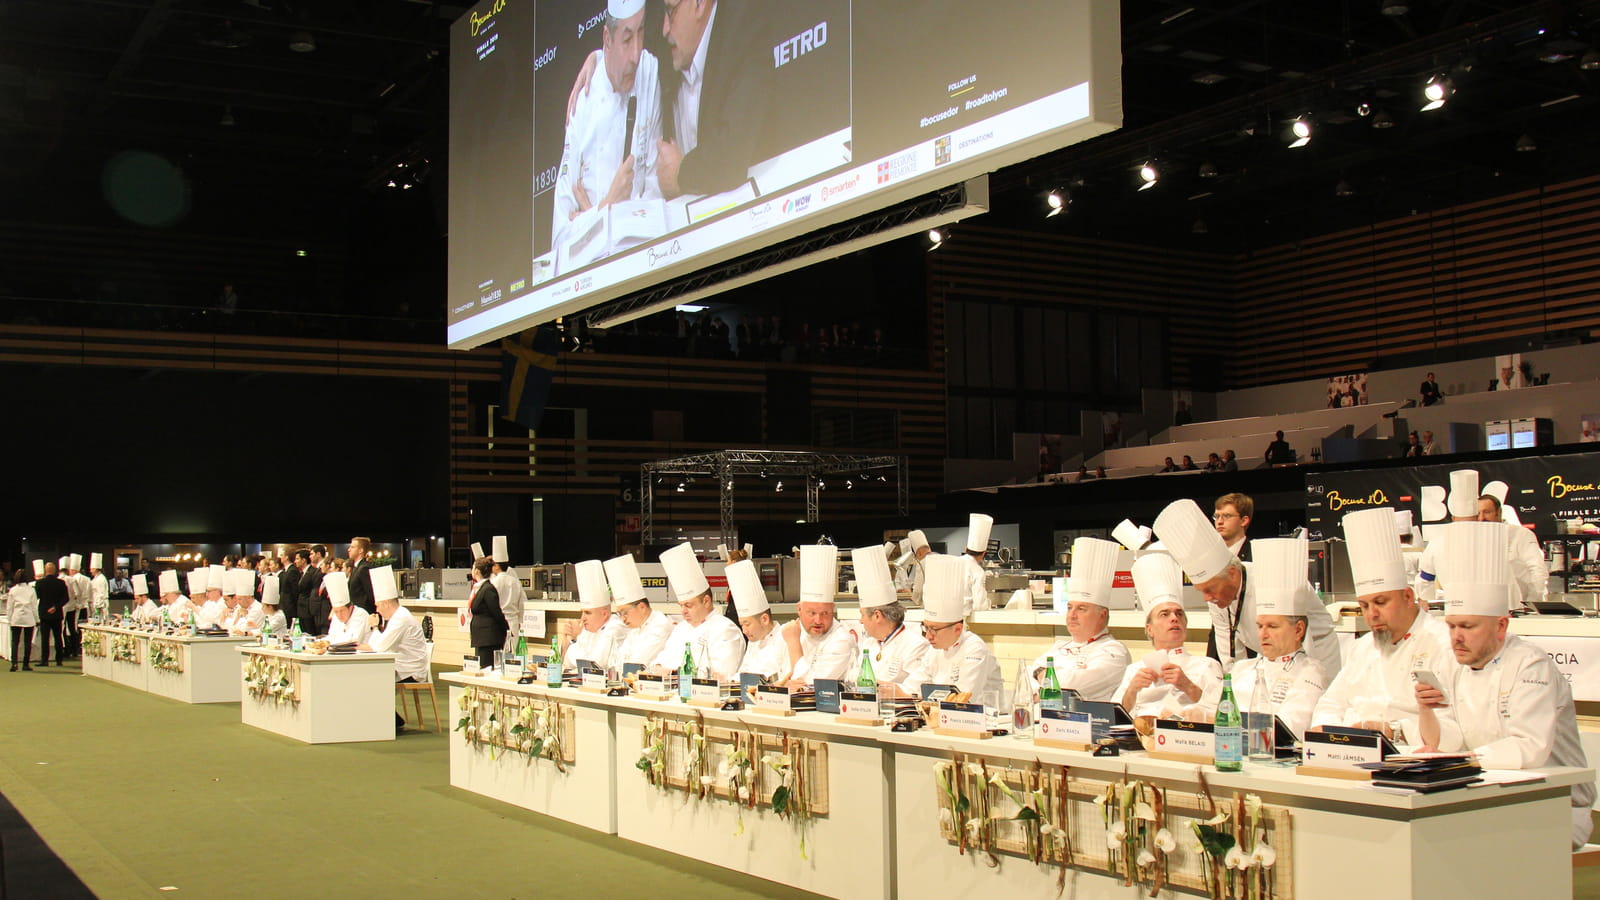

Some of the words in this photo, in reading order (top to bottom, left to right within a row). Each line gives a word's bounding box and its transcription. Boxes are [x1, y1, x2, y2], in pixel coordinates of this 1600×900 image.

[947, 78, 969, 92] FOLLOW
[969, 74, 977, 84] US
[919, 105, 959, 129] #bocusedor
[964, 87, 1008, 111] #roadtolyon
[958, 131, 994, 150] DESTINATIONS
[795, 193, 812, 208] WOW
[1547, 475, 1595, 499] Bocuse
[1326, 490, 1366, 511] Bocuse
[1367, 489, 1389, 505] d'Or
[641, 578, 666, 588] ETRO
